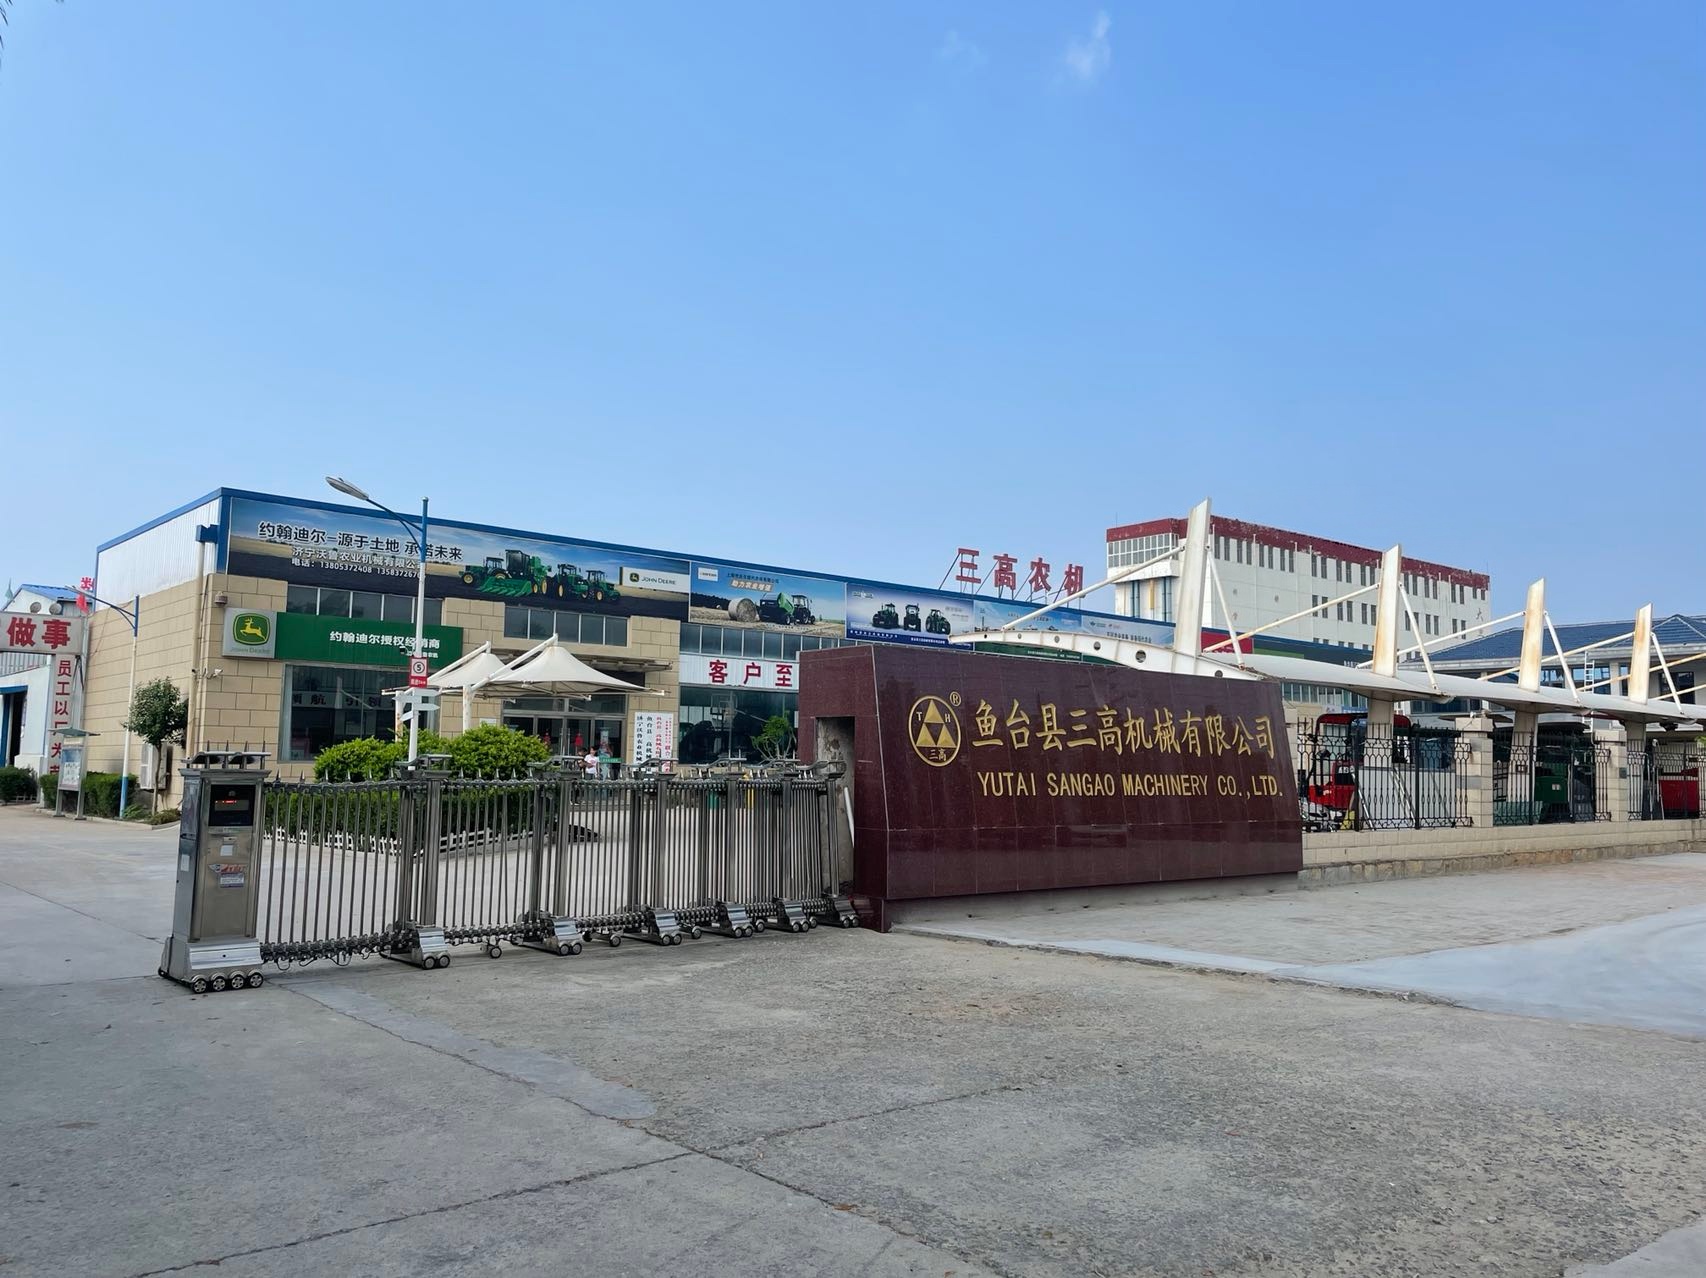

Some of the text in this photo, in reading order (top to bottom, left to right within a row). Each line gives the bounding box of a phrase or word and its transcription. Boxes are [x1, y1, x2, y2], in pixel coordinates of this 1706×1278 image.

[641, 576, 676, 586] JOHN DEERE
[956, 548, 1083, 597] 三高农机
[7, 617, 71, 650] 做事
[709, 660, 793, 687] 客户至
[916, 711, 951, 723] T H
[971, 699, 1275, 759] 鱼台县三高机械有限公司
[929, 748, 947, 761] 三高
[977, 772, 1036, 796] YUTAI
[1048, 772, 1115, 796] SANGAO
[1122, 774, 1209, 797] MACHINERY
